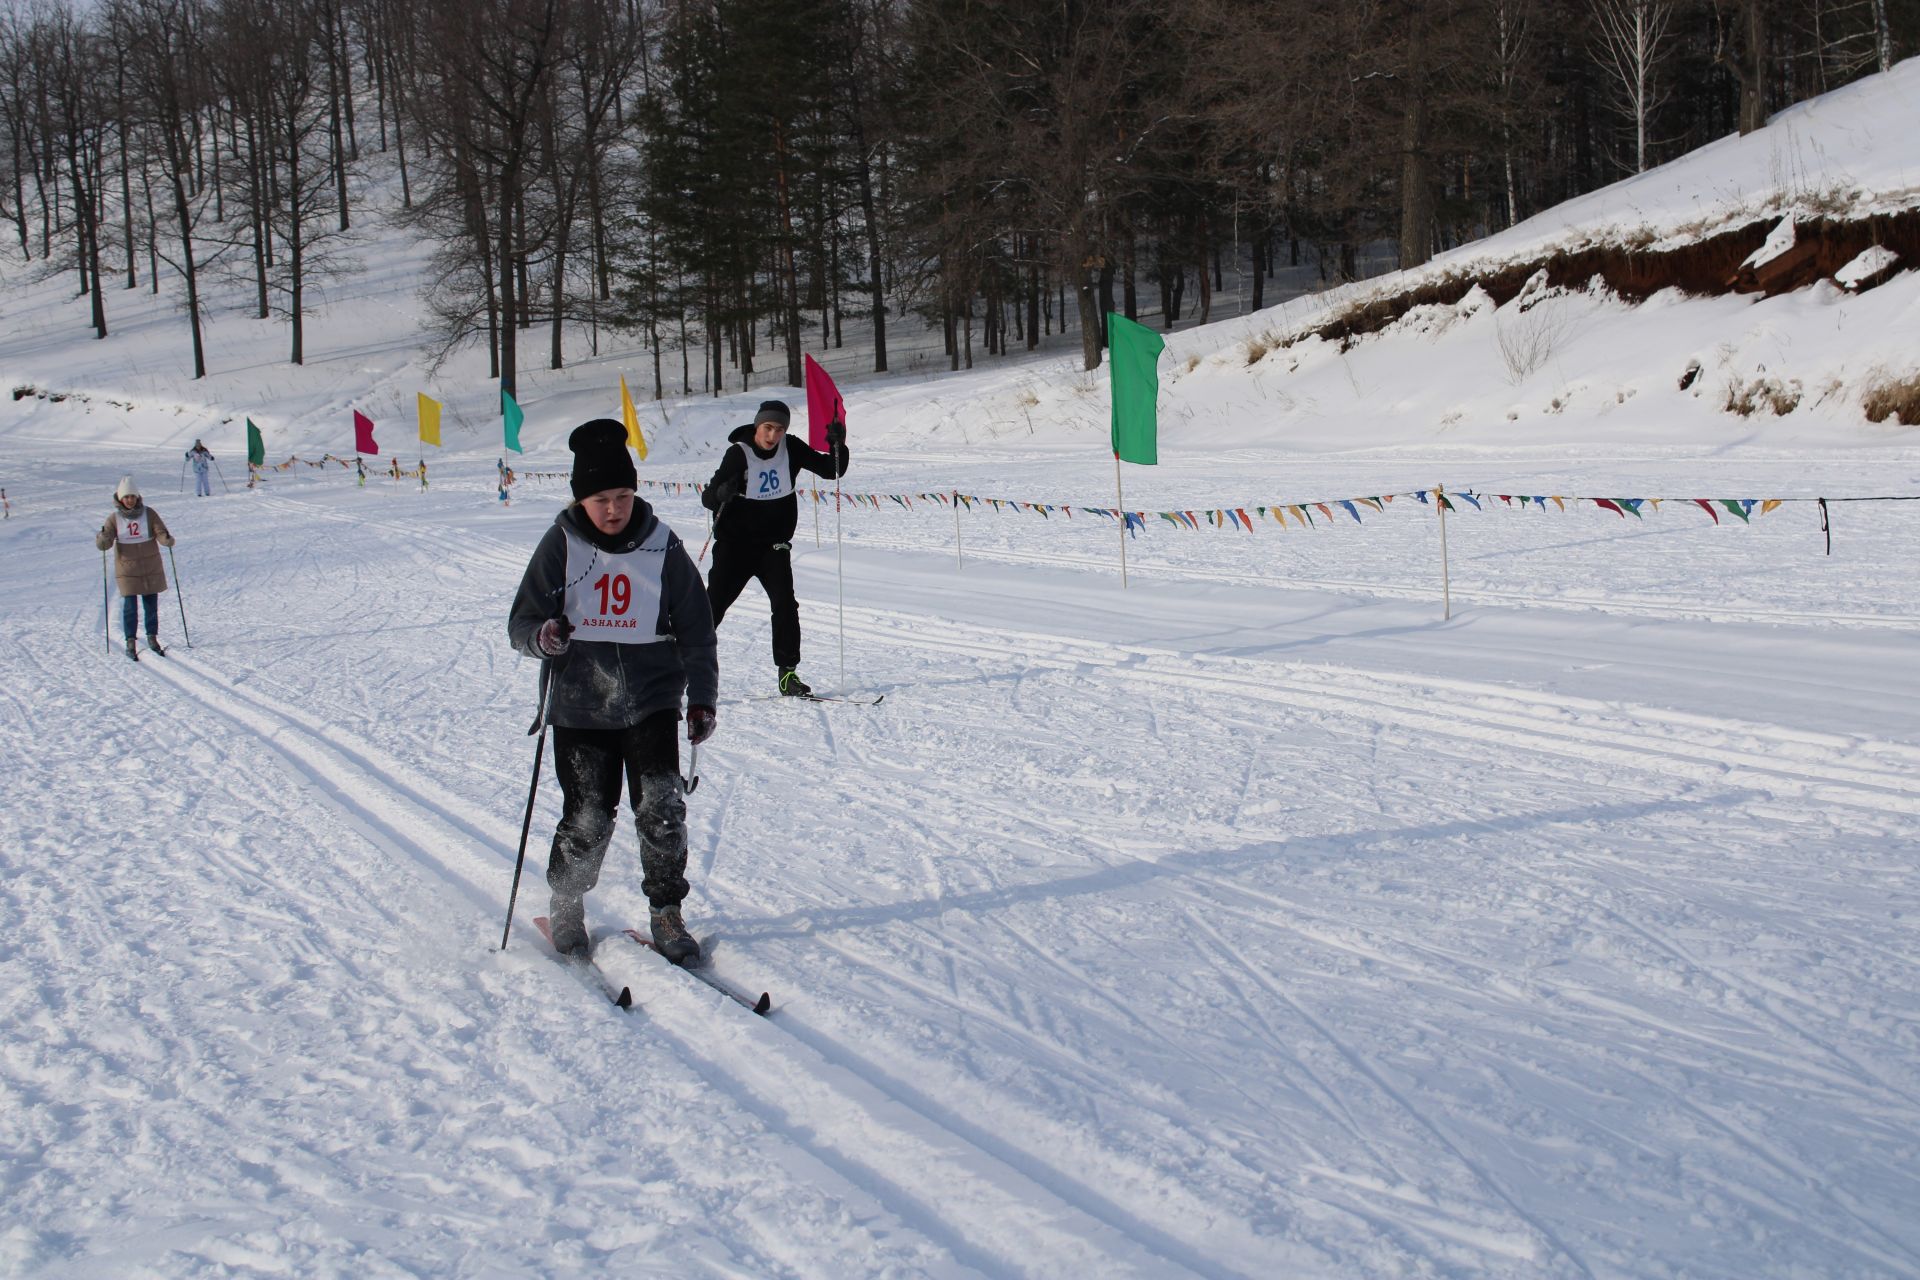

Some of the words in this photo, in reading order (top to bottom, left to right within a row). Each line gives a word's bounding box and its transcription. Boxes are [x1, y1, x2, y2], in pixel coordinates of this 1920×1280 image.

[759, 469, 780, 493] 26
[127, 522, 140, 536] 12
[594, 573, 631, 615] 19
[582, 618, 637, 628] АЗНАКАЙ
